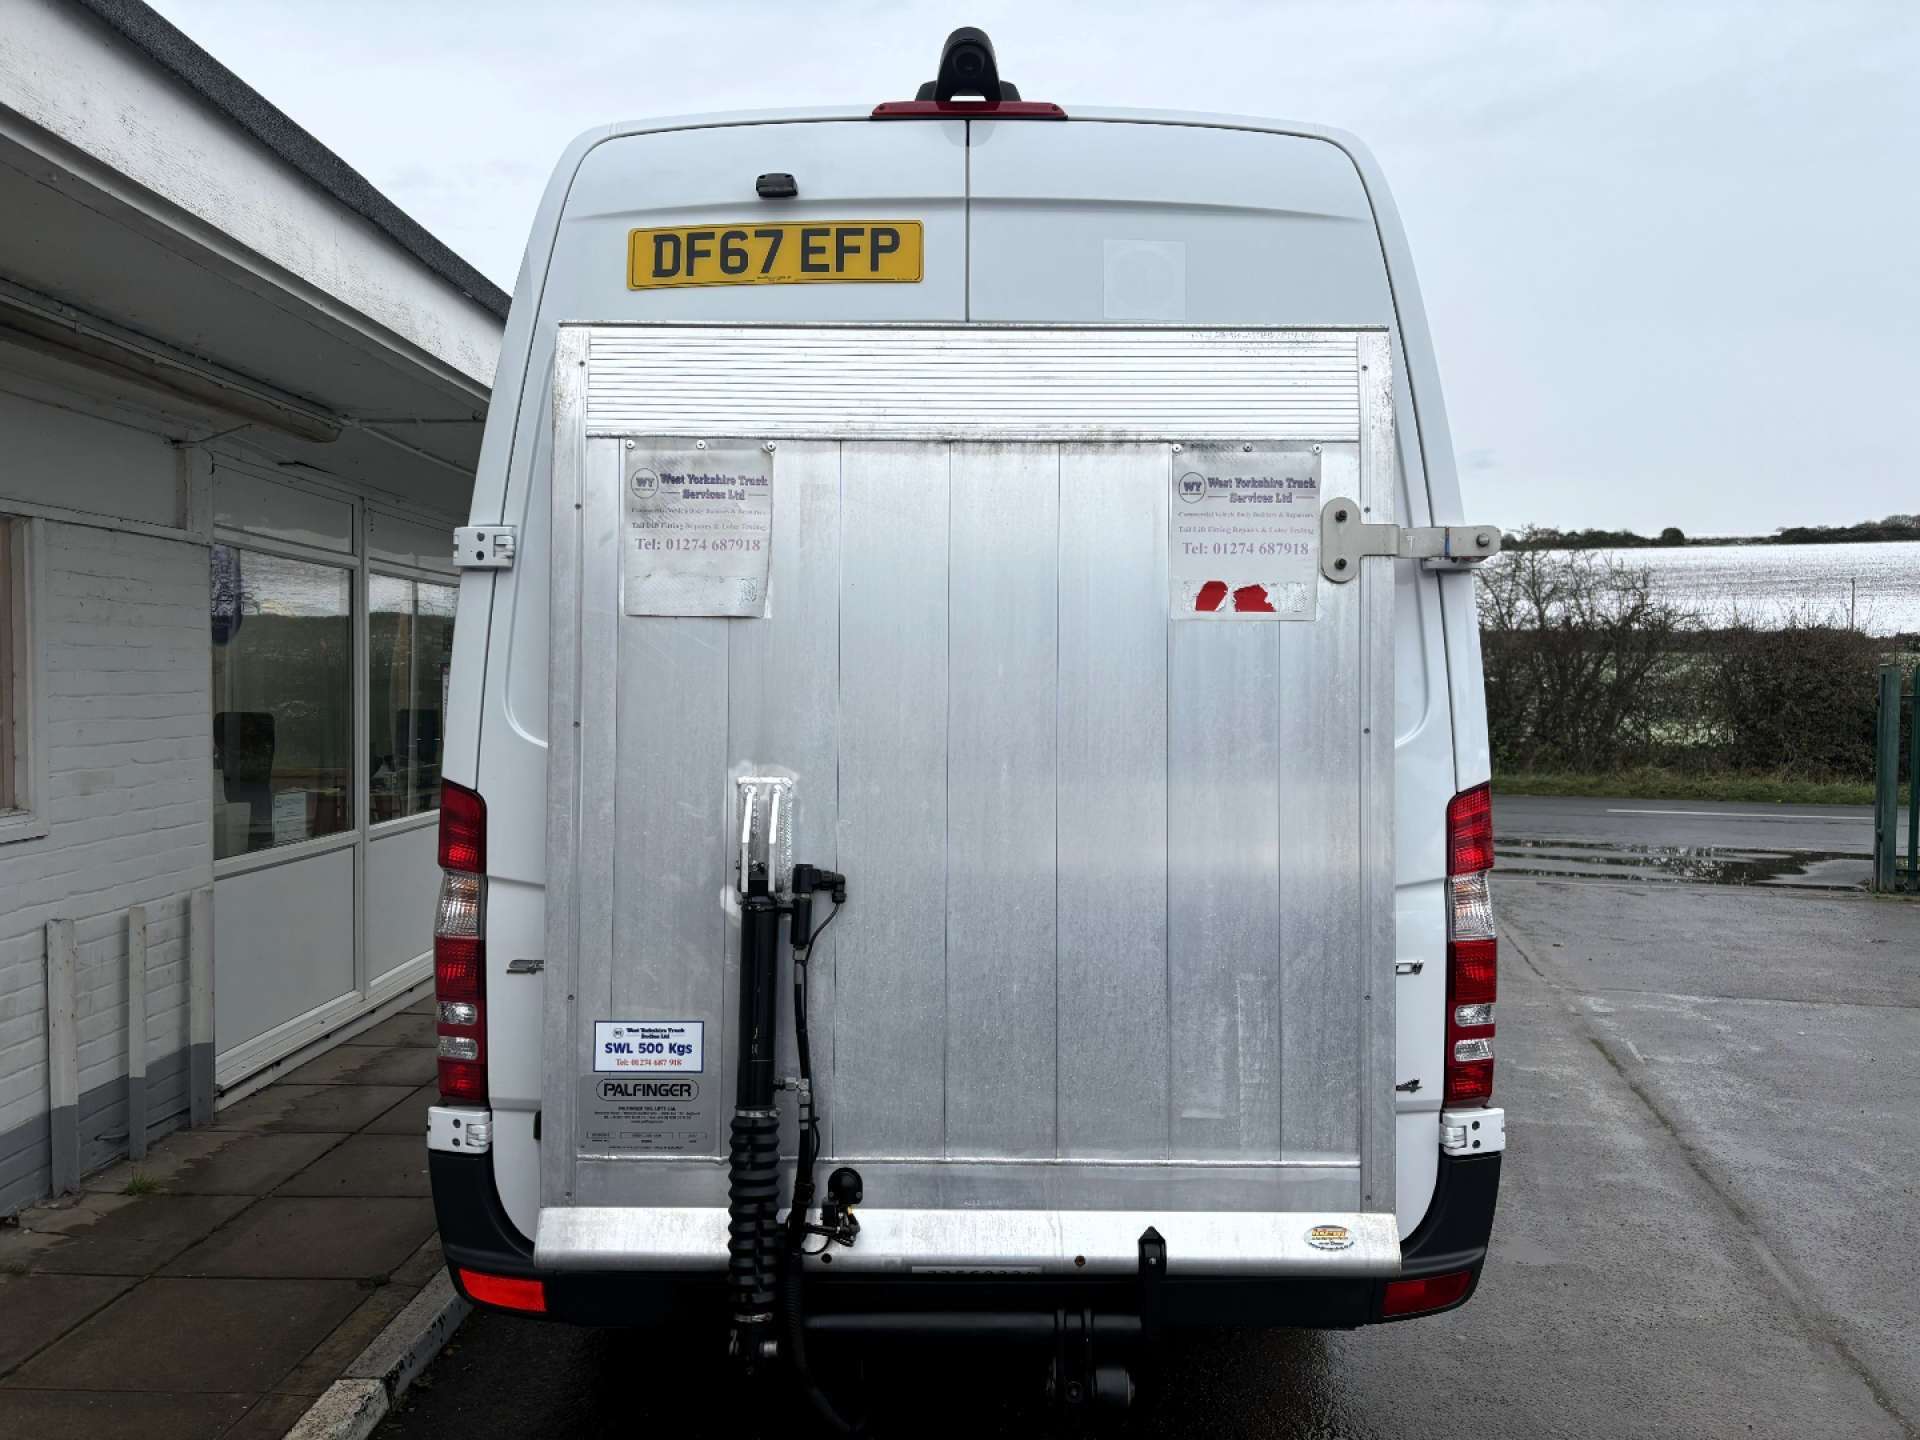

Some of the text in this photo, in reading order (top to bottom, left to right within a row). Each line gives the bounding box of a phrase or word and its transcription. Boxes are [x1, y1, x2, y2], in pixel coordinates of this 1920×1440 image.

[652, 227, 900, 278] DF67 EFP
[660, 473, 769, 487] West Yorkshire Truck
[1207, 477, 1317, 489] West Yorkshire Truck
[682, 489, 745, 501] Services Ltd
[1229, 493, 1293, 504] Services Ltd
[635, 538, 761, 551] Tel: 01274 687918
[1182, 542, 1309, 555] Tel: 01274 687918
[605, 1042, 693, 1056] SWL 500 Kgs
[603, 1083, 692, 1097] PALFINGER
